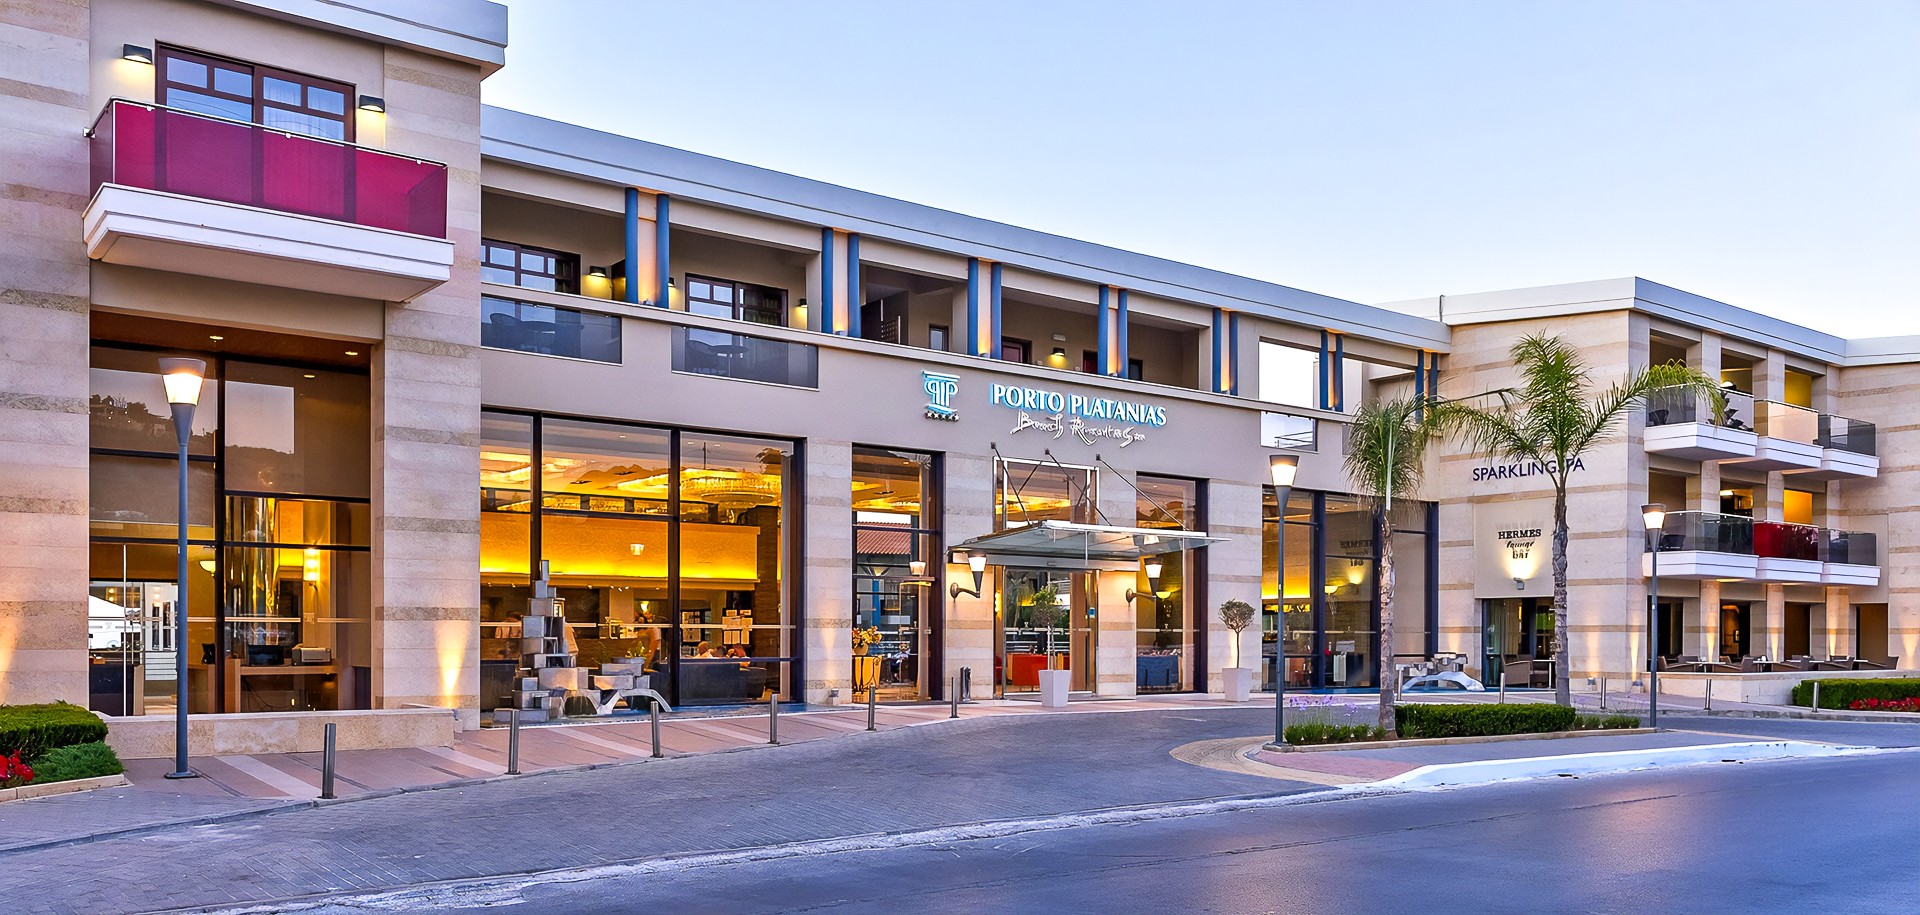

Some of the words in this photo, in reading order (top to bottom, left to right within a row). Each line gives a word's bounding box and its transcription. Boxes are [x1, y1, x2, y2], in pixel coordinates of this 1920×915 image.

[990, 383, 1065, 413] PORTO
[1068, 394, 1167, 426] PLATANIAS
[1472, 460, 1557, 481] SPARKLING
[1558, 457, 1585, 473] PA
[1498, 529, 1541, 539] HERMES
